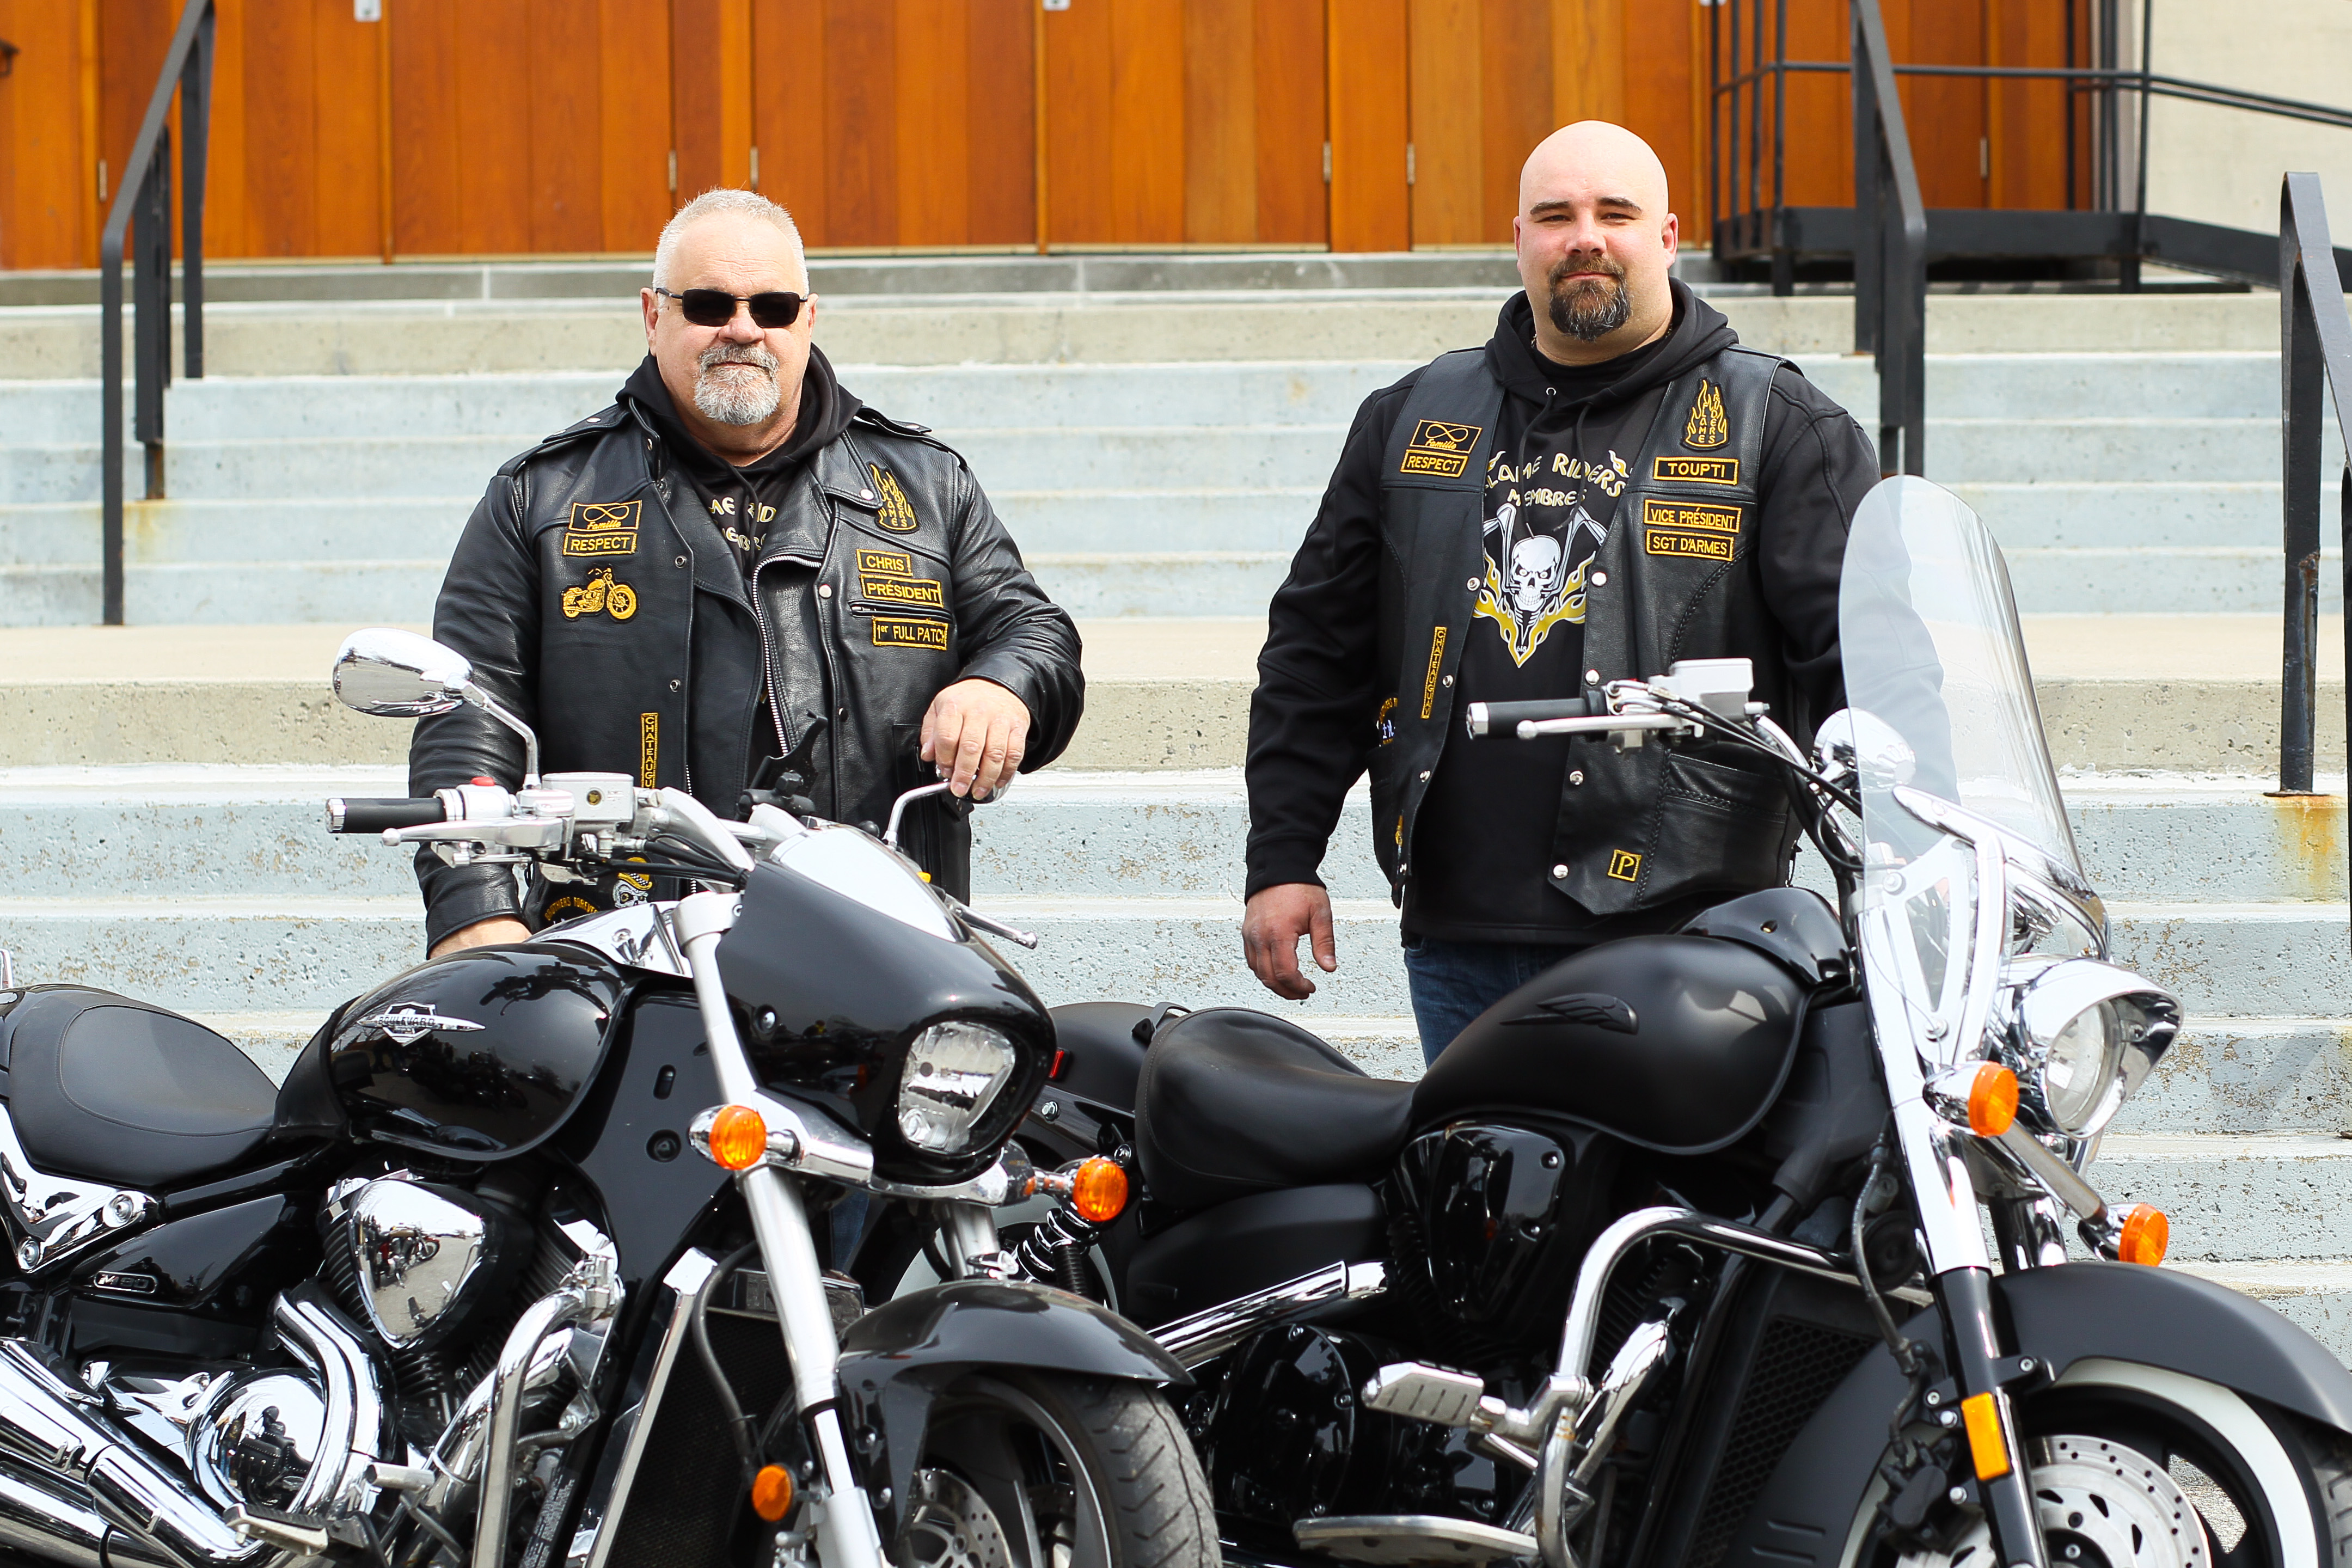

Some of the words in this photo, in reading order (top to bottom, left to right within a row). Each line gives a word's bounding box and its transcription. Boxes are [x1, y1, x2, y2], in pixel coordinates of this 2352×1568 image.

[1698, 402, 1708, 443] FLAME
[1708, 394, 1721, 444] RIDERS
[1425, 438, 1457, 449] Famille
[1407, 456, 1461, 472] RESPECT
[1668, 462, 1725, 477] TOUPTI
[1485, 455, 1542, 488] LAME
[1552, 452, 1626, 498] RIDERS
[883, 486, 898, 526] FLAME
[587, 519, 622, 530] Famille
[1651, 508, 1675, 523] VICE
[1679, 507, 1735, 529] PRÉSIDENT
[570, 536, 630, 551] RESPECT
[1653, 536, 1677, 550] SGT
[1680, 537, 1728, 555] D'ARMES
[866, 555, 905, 571] CHRIS
[866, 580, 939, 602] PRÉSIDENT
[877, 624, 889, 639] 1er
[893, 625, 916, 641] FULL
[1424, 630, 1444, 715] CHATEAUGUAY
[645, 716, 655, 788] CHATEAUGU
[1617, 855, 1634, 874] P
[378, 1015, 435, 1027] BOULEVARD
